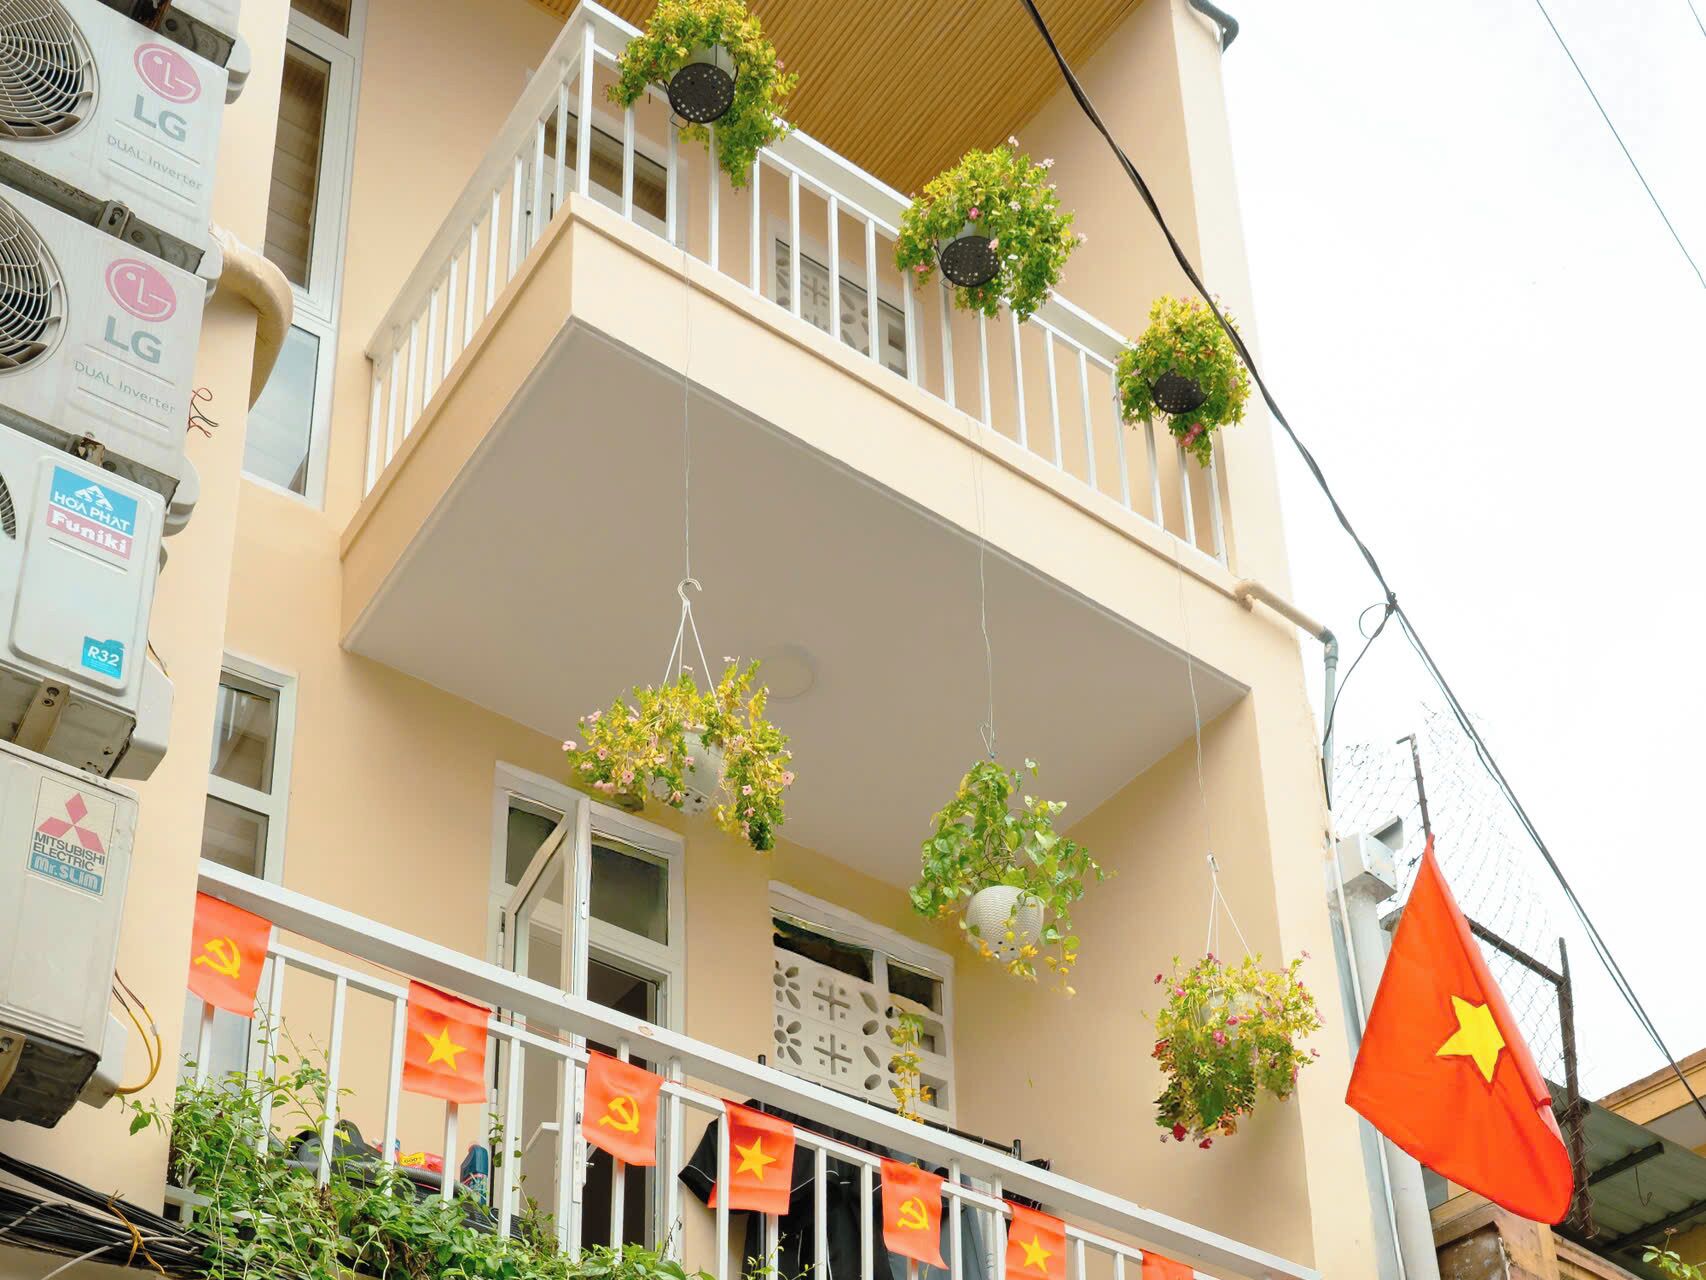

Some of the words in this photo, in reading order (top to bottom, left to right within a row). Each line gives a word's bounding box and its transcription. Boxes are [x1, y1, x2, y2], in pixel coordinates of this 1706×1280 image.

[133, 93, 187, 142] LG
[107, 134, 145, 161] DUAL
[104, 315, 162, 364] LG
[74, 360, 114, 387] DUAL
[51, 509, 127, 553] Funiki
[88, 645, 120, 667] R32
[33, 842, 95, 872] ELECTRIC
[34, 831, 105, 866] MITSUBISHI
